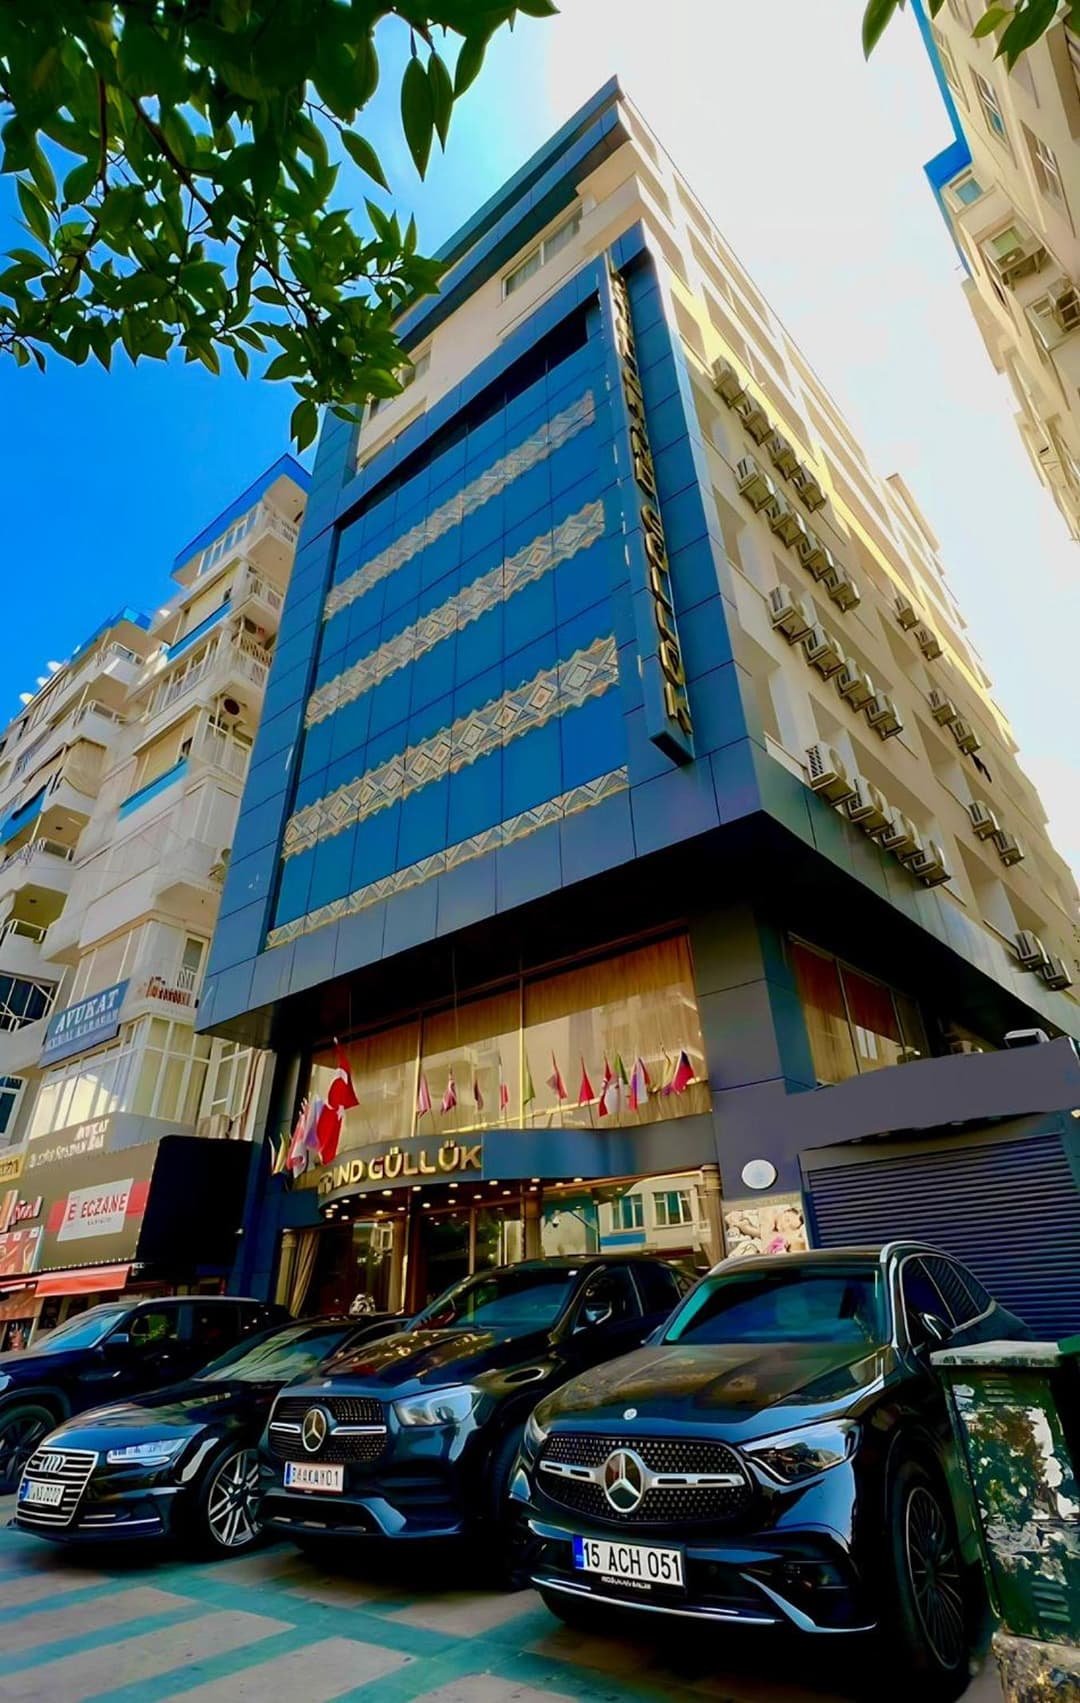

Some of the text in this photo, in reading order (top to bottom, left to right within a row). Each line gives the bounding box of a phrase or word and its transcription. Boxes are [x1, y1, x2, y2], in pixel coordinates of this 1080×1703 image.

[55, 988, 121, 1034] AVUKAT
[367, 1140, 483, 1181] GÜLLÜK
[80, 1192, 127, 1219] ECZANE
[584, 1541, 681, 1582] 15 ACH 051
